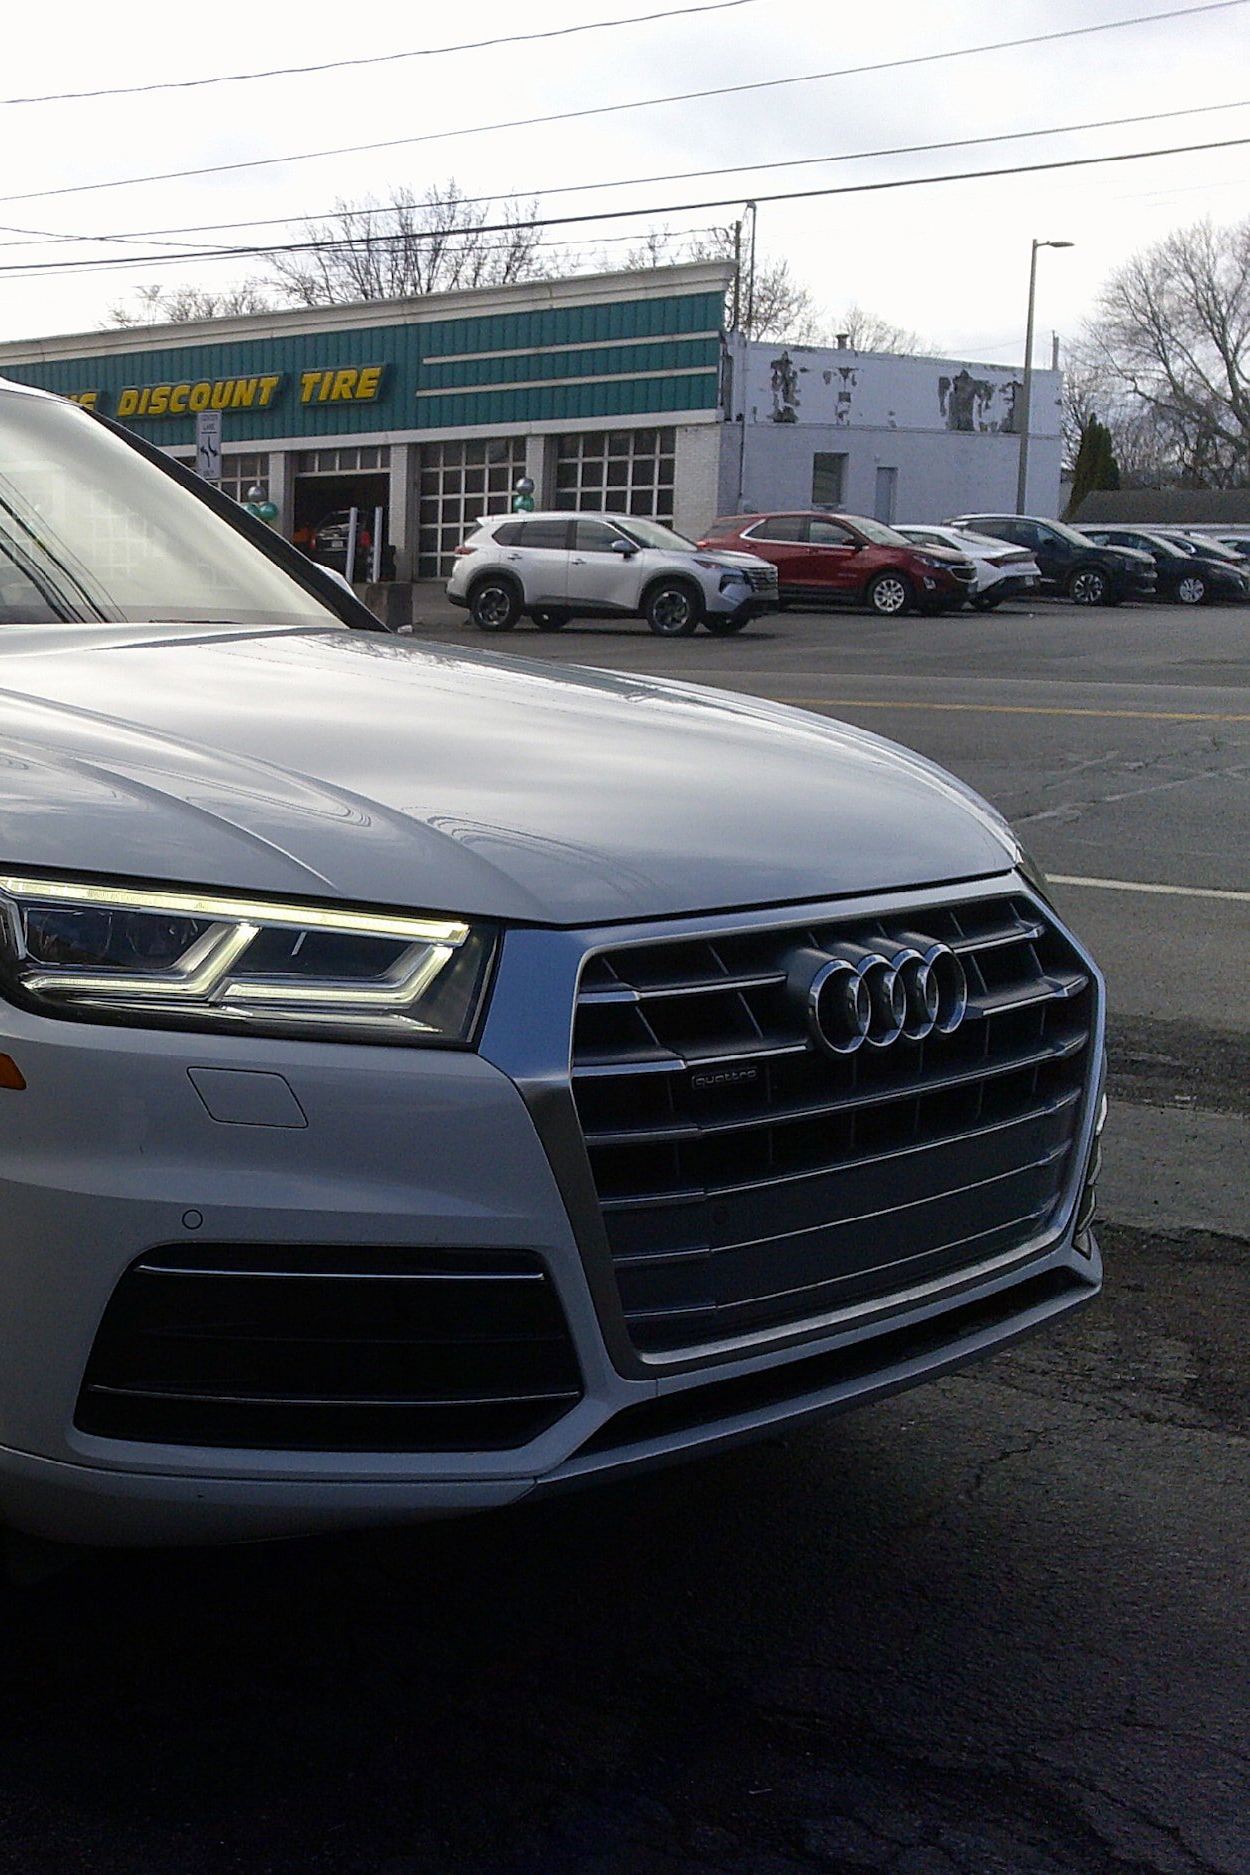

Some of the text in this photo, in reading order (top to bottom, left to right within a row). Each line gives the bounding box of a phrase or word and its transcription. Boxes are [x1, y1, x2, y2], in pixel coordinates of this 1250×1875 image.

[117, 376, 279, 417] DISCOUNT
[302, 366, 383, 403] TIRE
[695, 1069, 757, 1088] quattro
